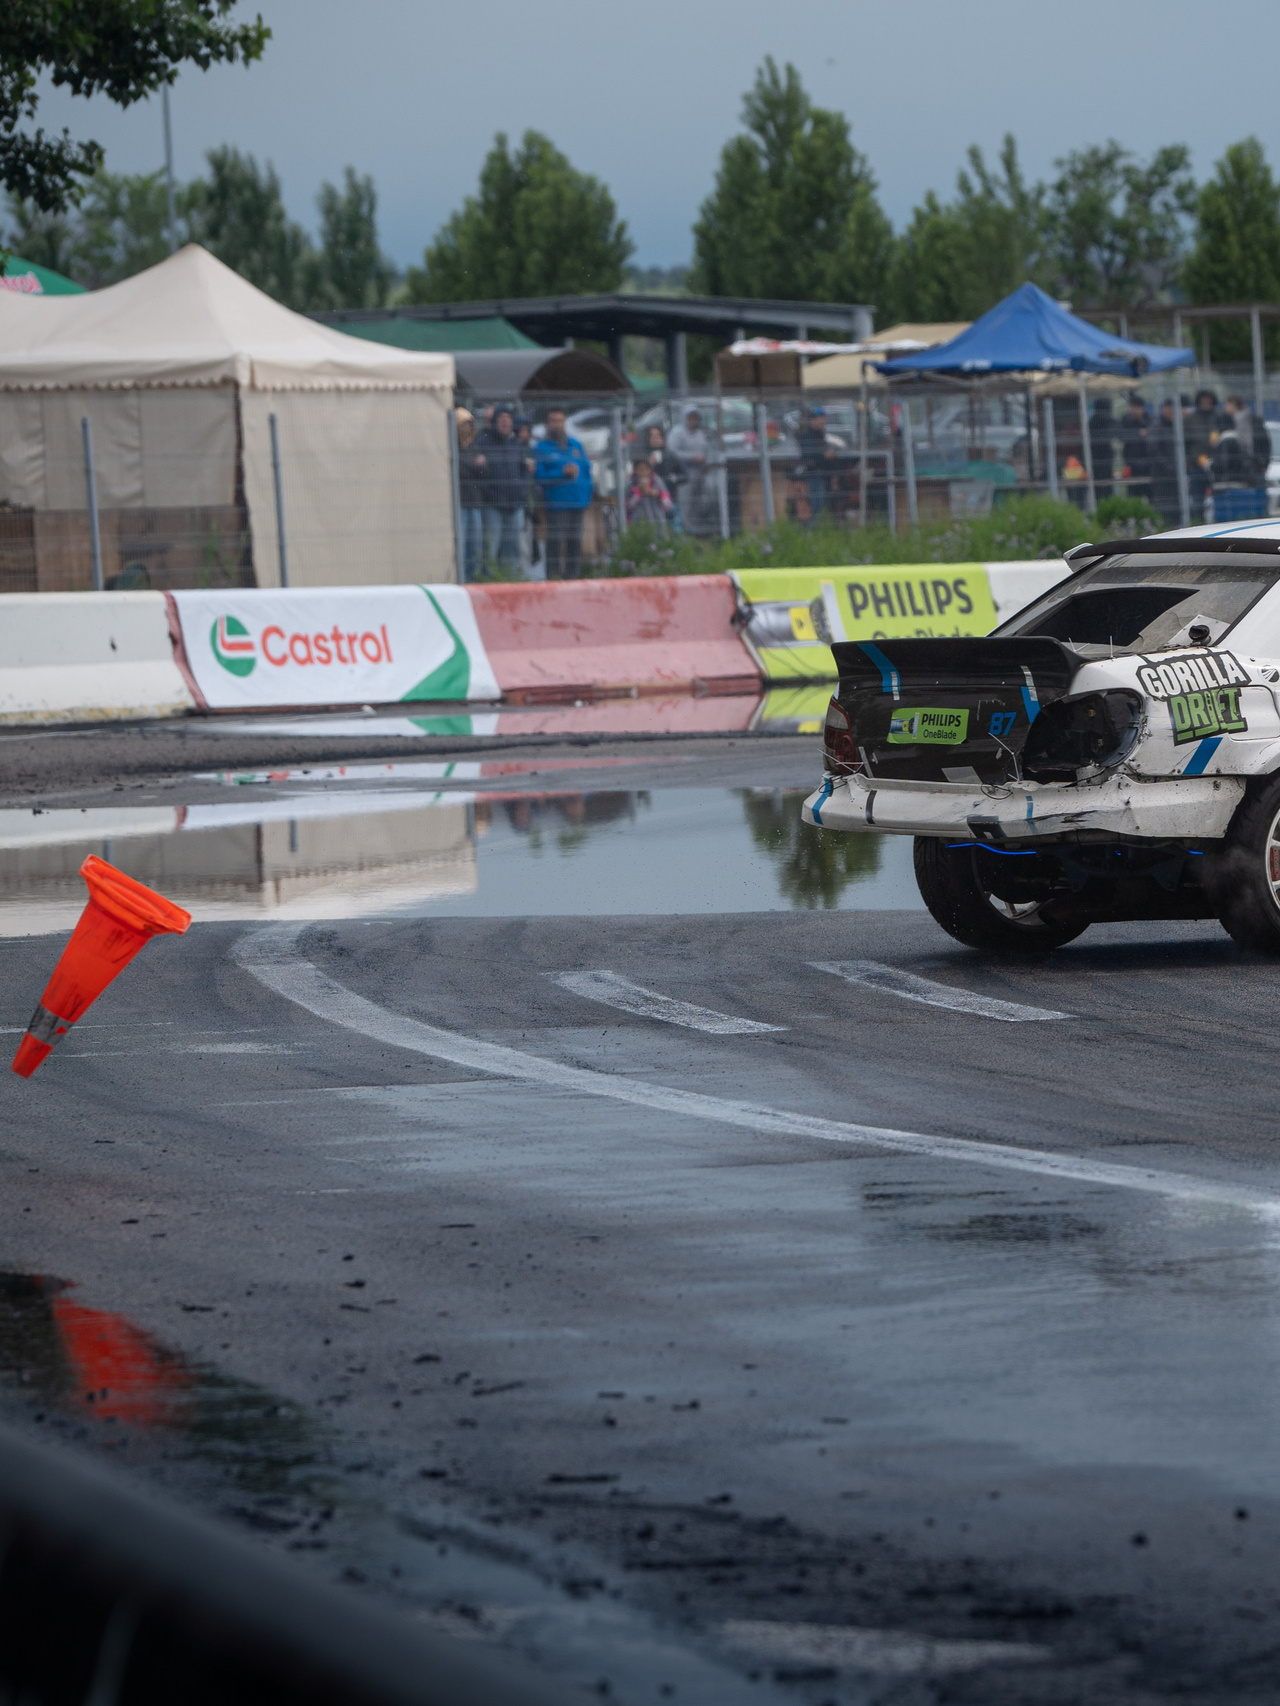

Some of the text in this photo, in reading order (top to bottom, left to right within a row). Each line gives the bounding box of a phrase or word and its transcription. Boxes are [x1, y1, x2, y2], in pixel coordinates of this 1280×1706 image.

[846, 578, 973, 619] PHILIPS
[261, 624, 393, 667] Castrol
[1140, 653, 1247, 698] GORILLA
[921, 713, 962, 727] PHILIPS
[923, 729, 957, 739] OneBlade
[989, 711, 1017, 736] 87
